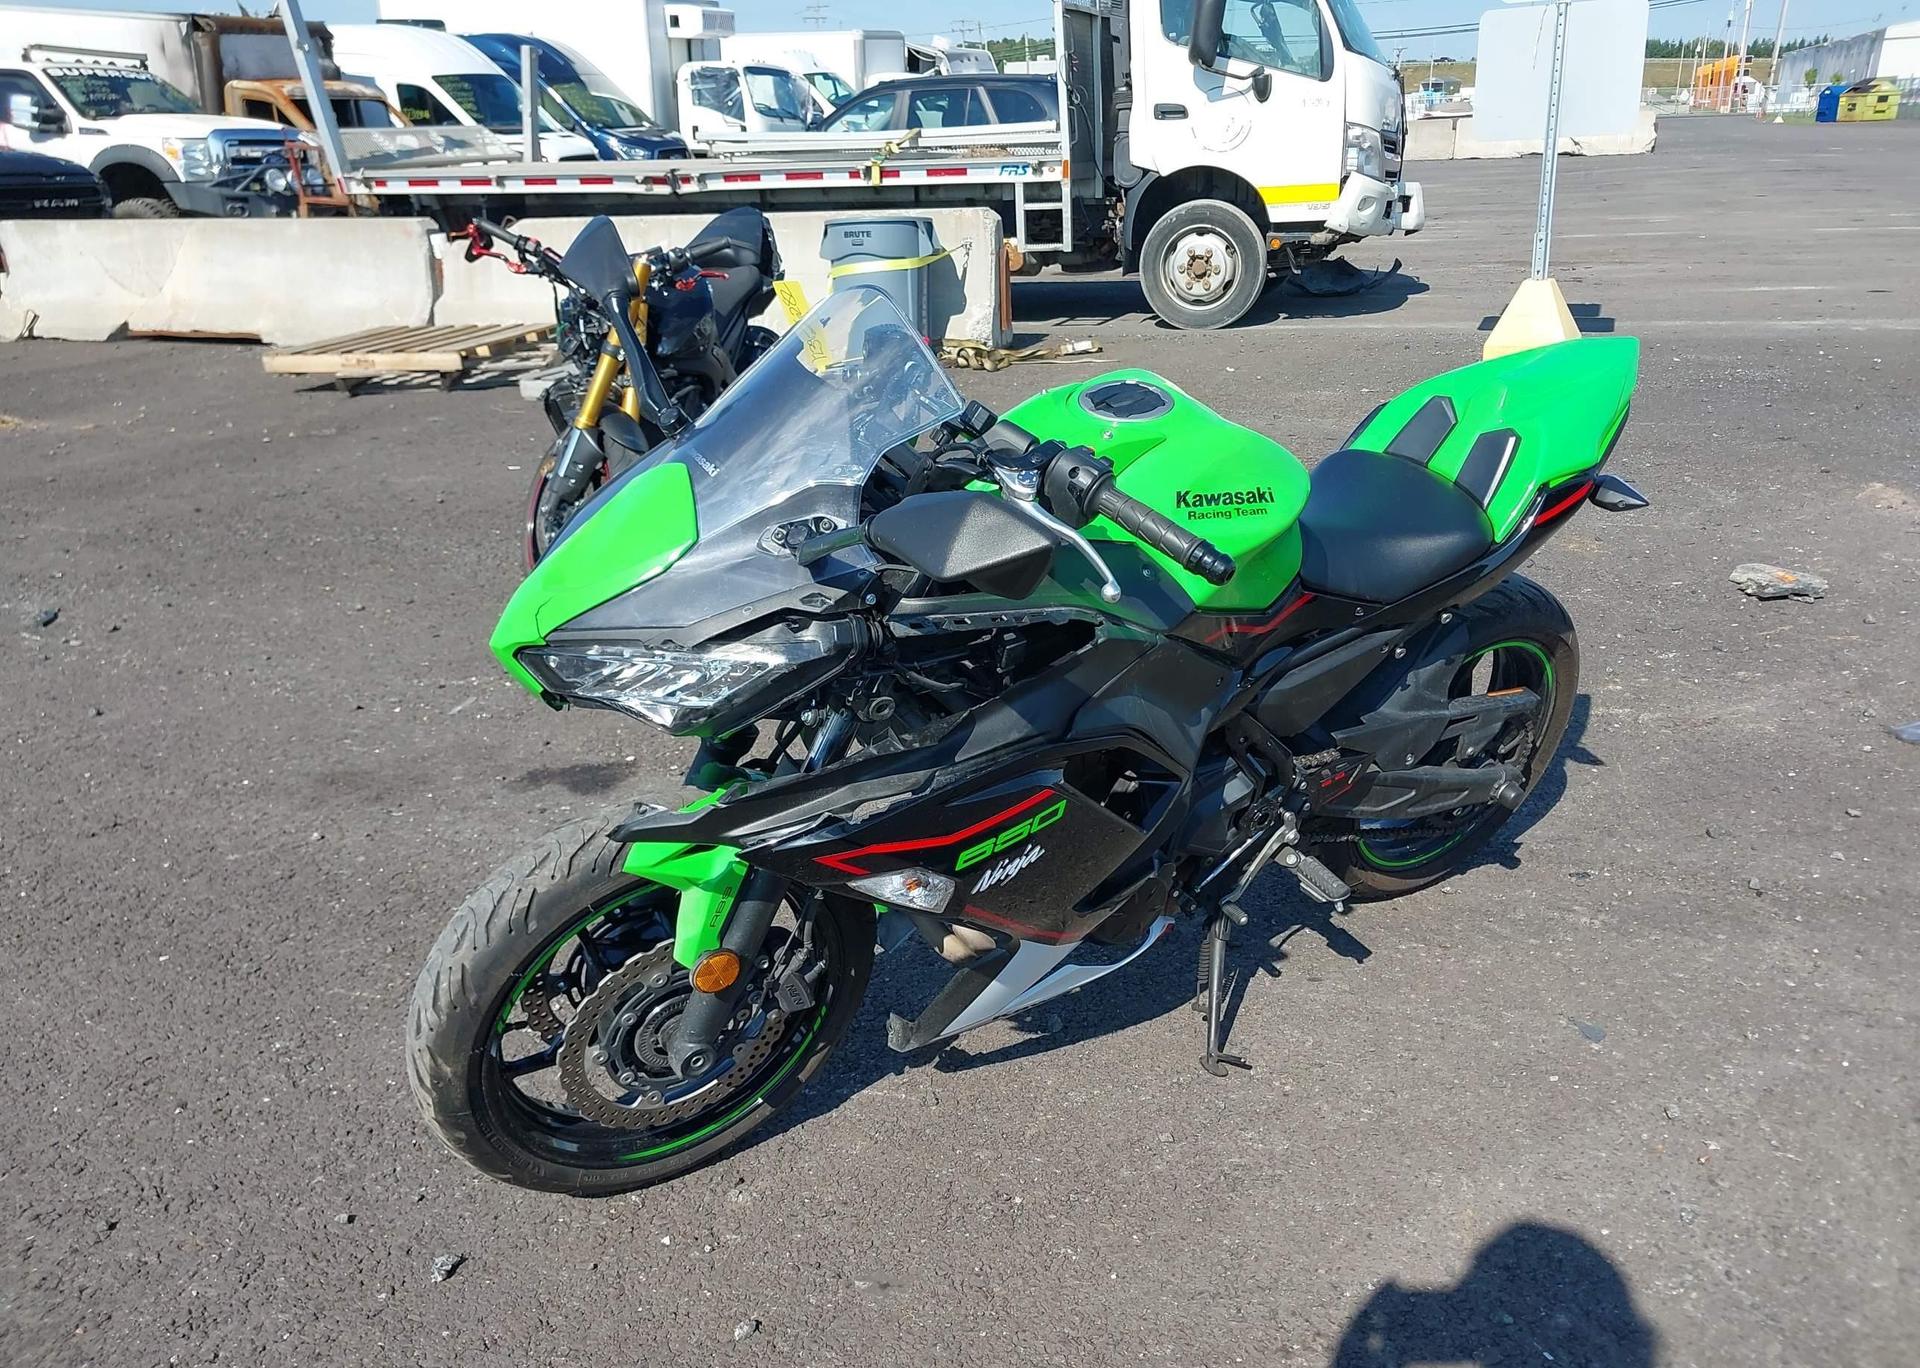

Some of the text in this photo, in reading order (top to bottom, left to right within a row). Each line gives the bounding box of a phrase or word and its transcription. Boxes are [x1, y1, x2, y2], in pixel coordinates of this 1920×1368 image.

[843, 230, 872, 239] BRUTE
[1176, 486, 1275, 509] Kawasaki
[1187, 507, 1268, 520] Racing Team
[955, 799, 1067, 871] 650
[970, 843, 1046, 895] Ninja
[709, 886, 733, 928] ABS
